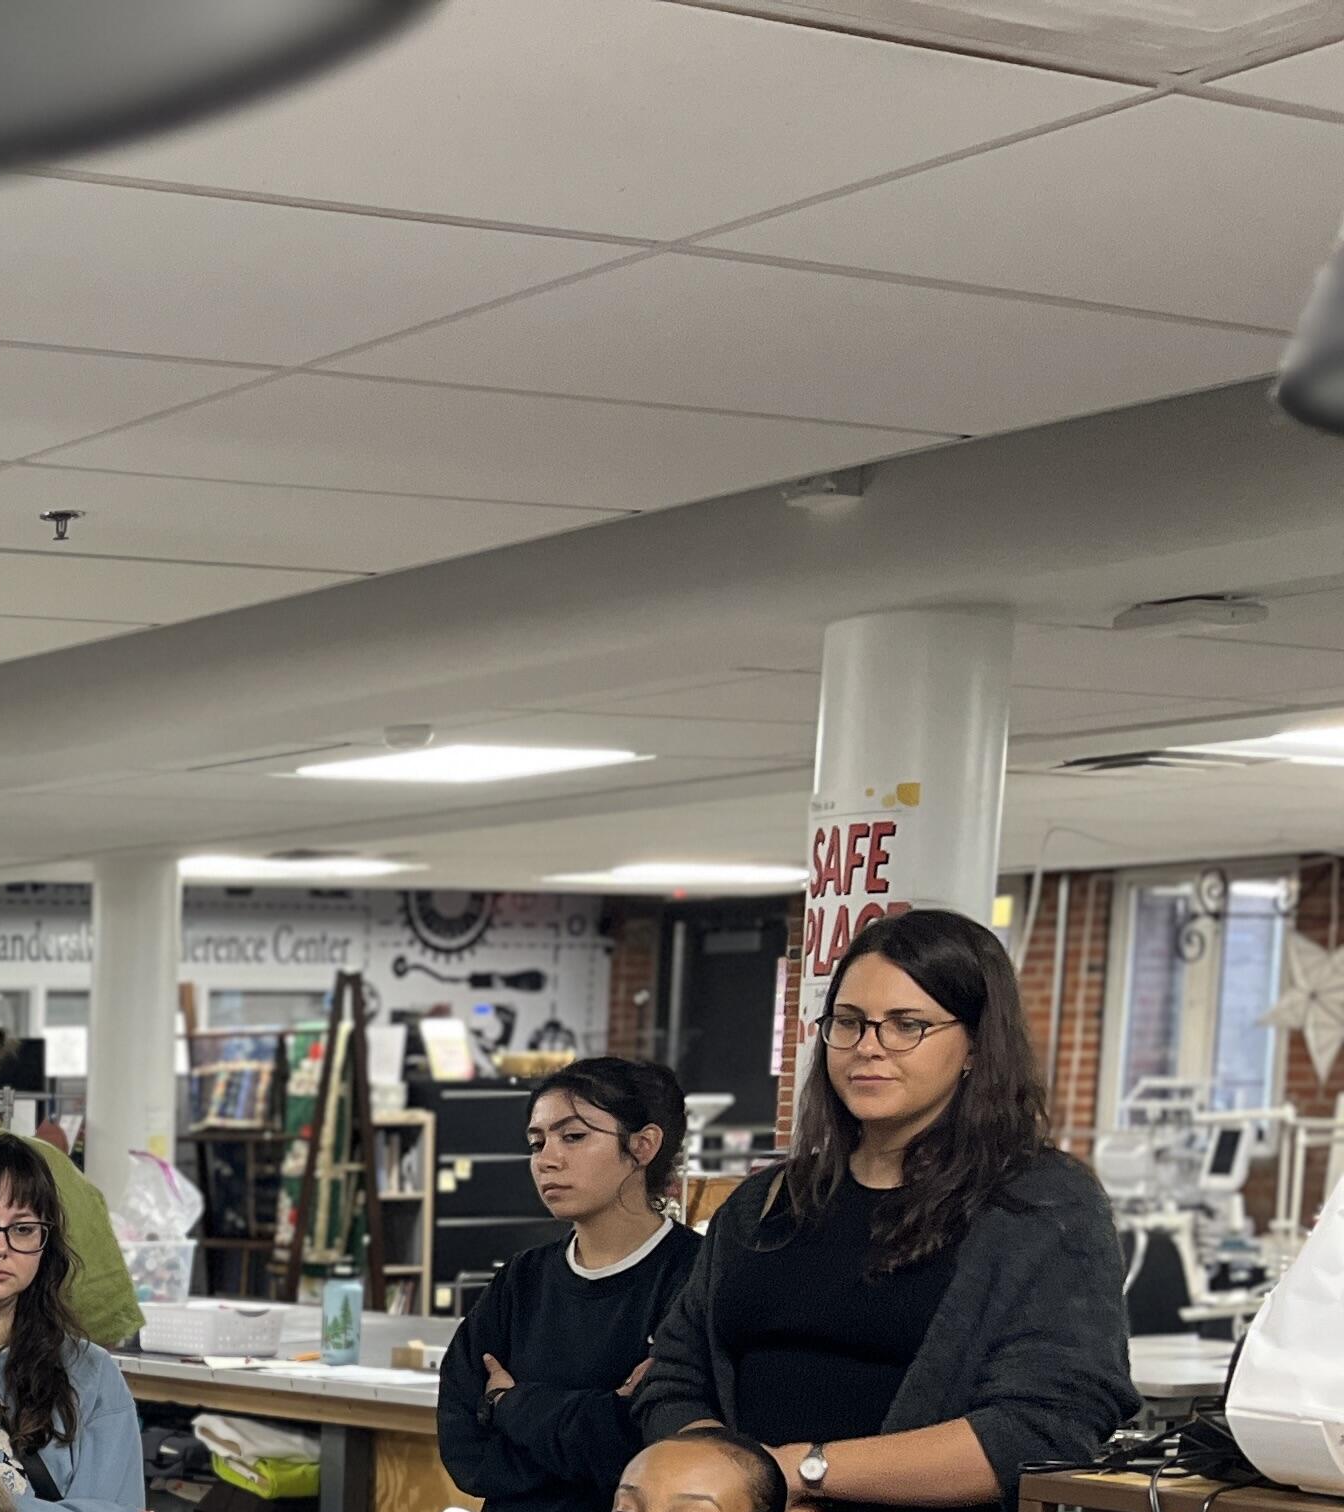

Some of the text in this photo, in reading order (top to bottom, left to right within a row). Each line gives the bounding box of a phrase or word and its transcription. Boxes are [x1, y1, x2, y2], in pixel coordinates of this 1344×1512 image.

[811, 821, 896, 899] SAFE
[272, 922, 350, 965] Center
[803, 901, 912, 980] PLA
